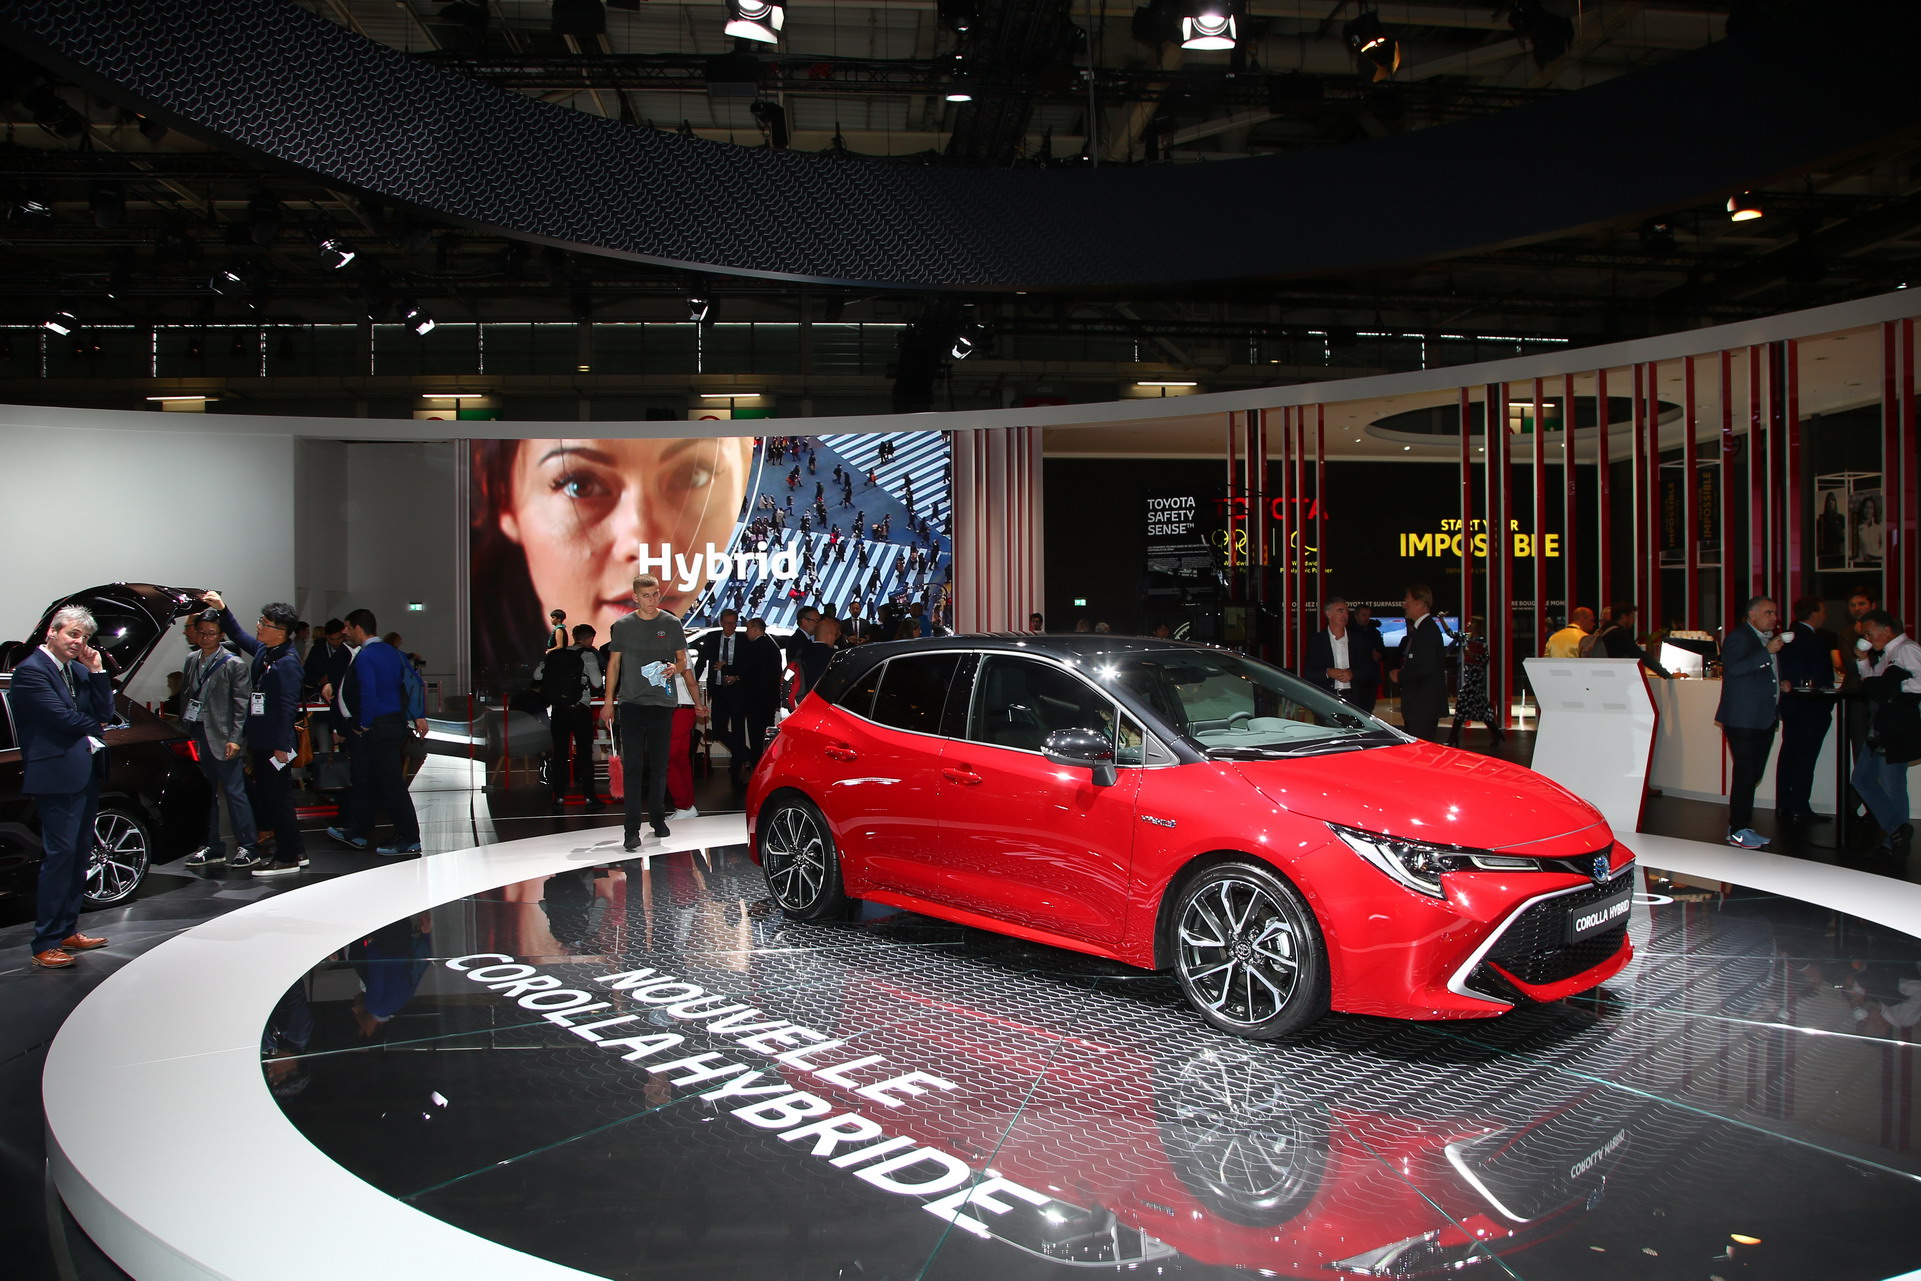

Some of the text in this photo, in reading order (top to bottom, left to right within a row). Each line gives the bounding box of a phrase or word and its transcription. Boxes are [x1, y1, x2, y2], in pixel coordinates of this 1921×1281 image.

[1147, 496, 1196, 510] TOYOTA
[1147, 510, 1195, 523] SAFETY
[1212, 497, 1329, 520] TOOA
[1400, 533, 1559, 558] IMPOSBLE
[638, 540, 799, 591] Hybrid
[1575, 899, 1630, 932] COROLLA HYBRID
[596, 967, 959, 1108] NOUVELLE
[445, 953, 1053, 1238] COROLLA HYBRIDE
